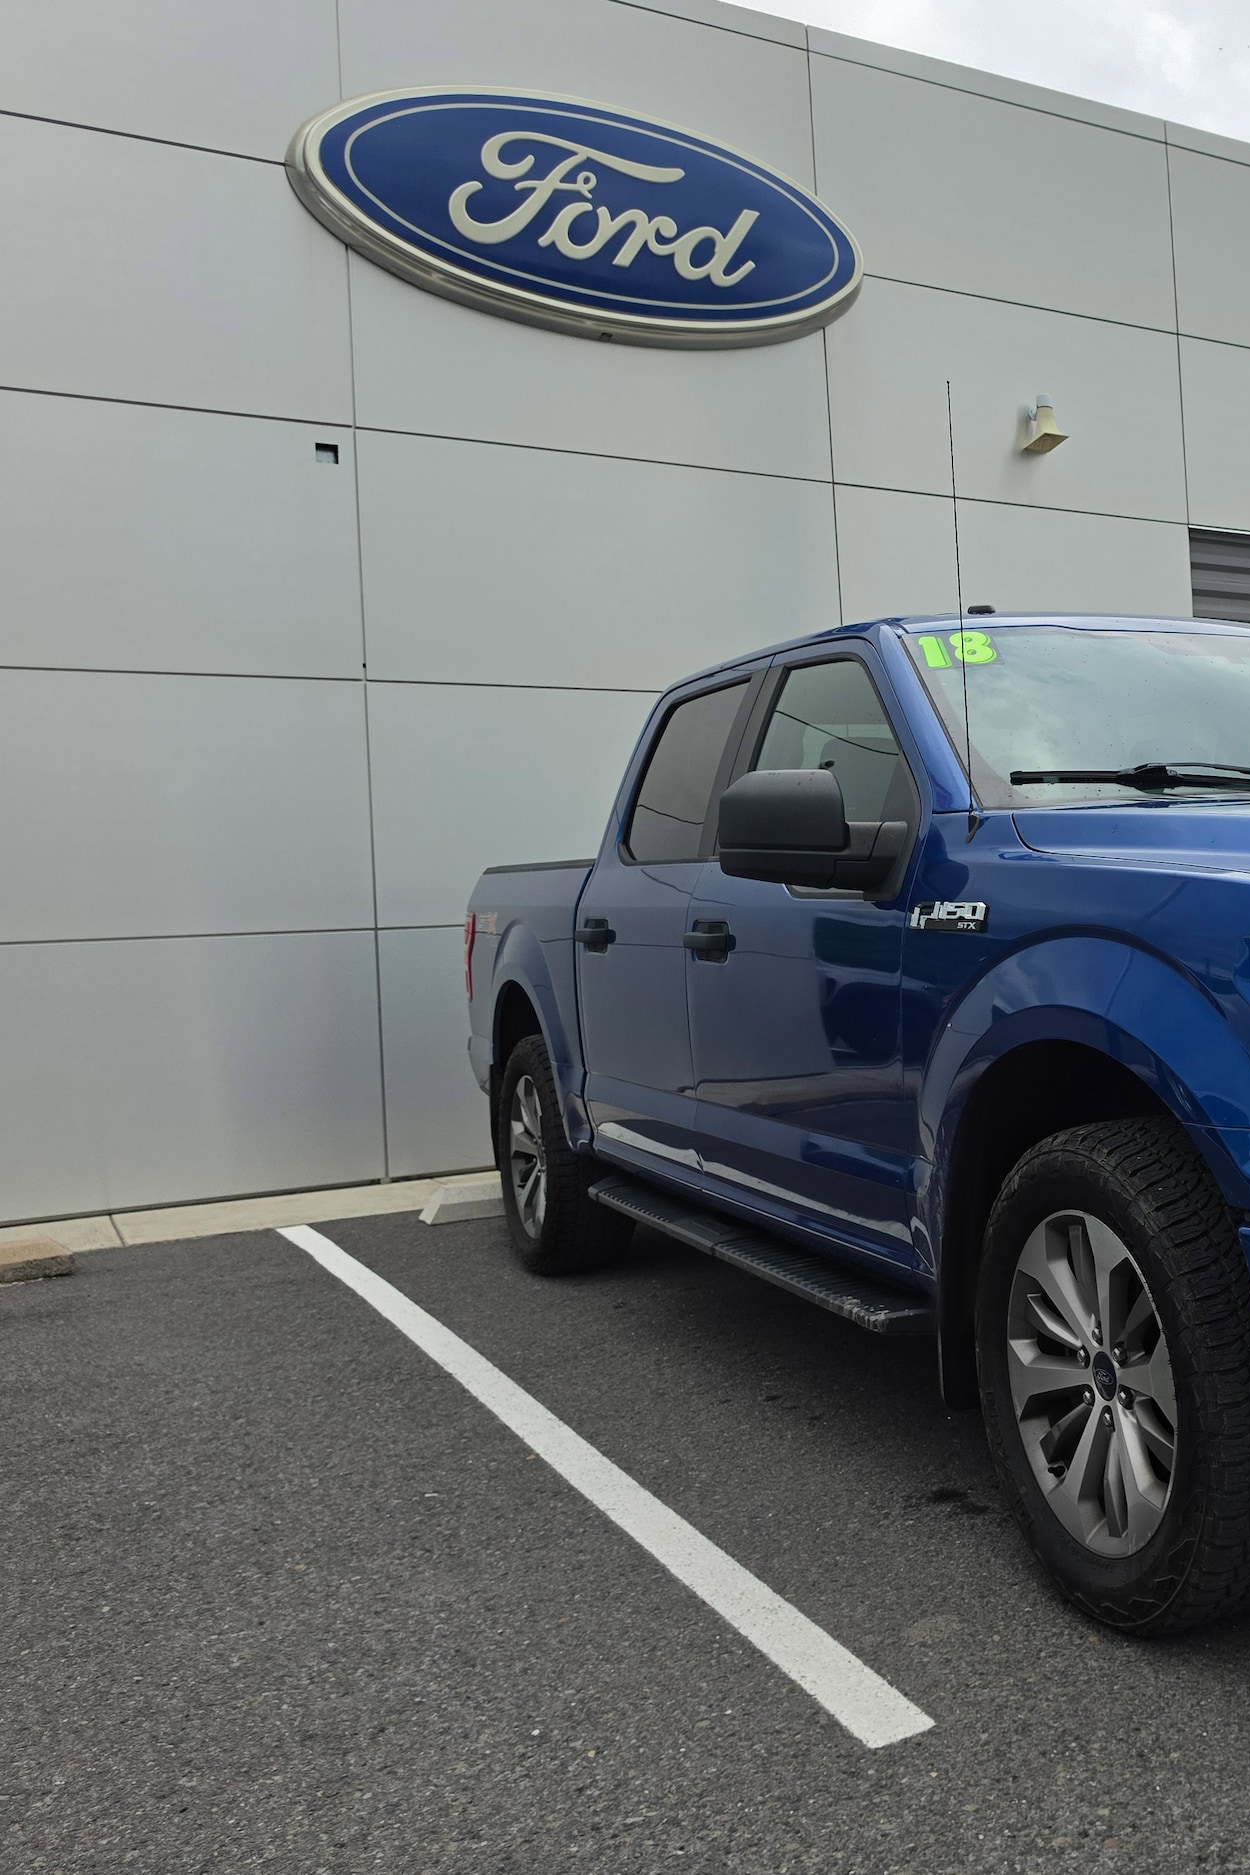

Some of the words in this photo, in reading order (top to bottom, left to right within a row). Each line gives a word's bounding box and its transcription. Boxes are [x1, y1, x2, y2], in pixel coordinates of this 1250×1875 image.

[448, 130, 760, 288] Ford
[918, 631, 998, 669] 18
[957, 921, 977, 930] STX
